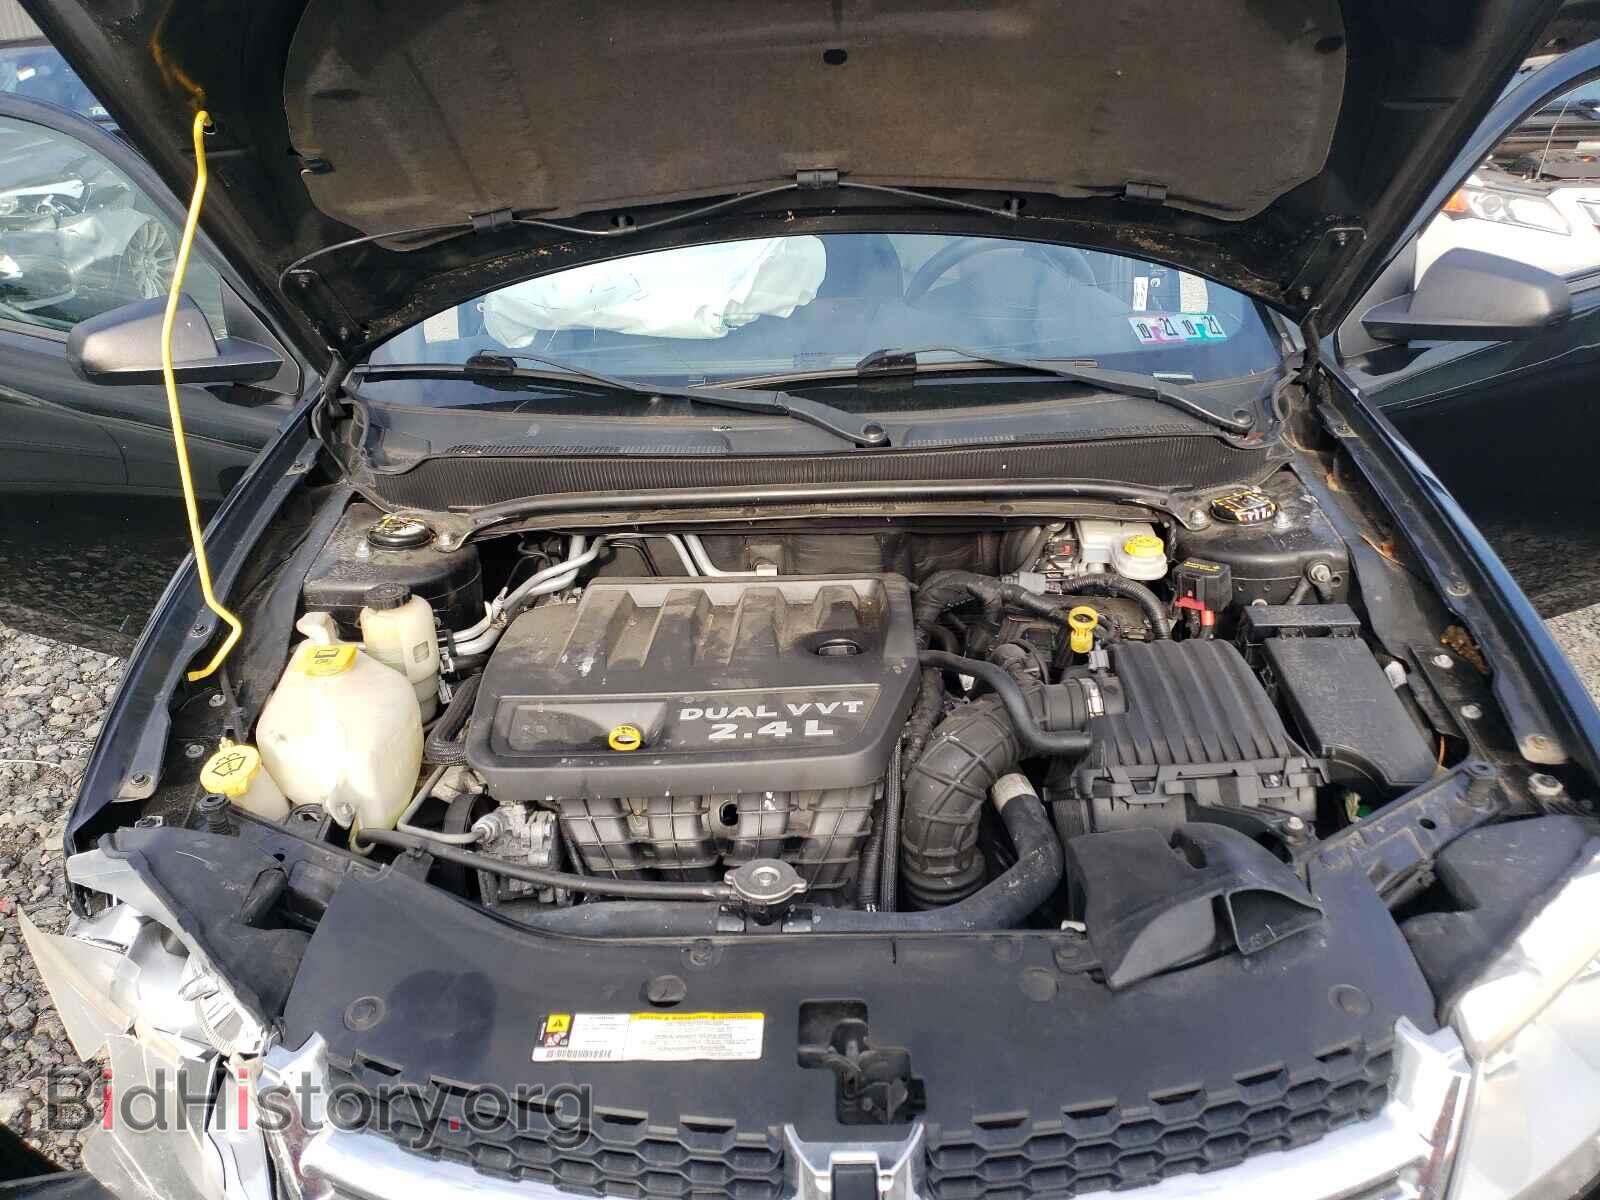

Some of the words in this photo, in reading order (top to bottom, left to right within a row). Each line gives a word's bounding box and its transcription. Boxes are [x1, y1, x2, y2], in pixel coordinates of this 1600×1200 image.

[1159, 317, 1179, 336] 21
[1202, 316, 1223, 334] 21
[679, 705, 778, 720] DUAL
[786, 700, 864, 716] VVT
[708, 720, 793, 740] 2.4
[804, 719, 834, 736] L
